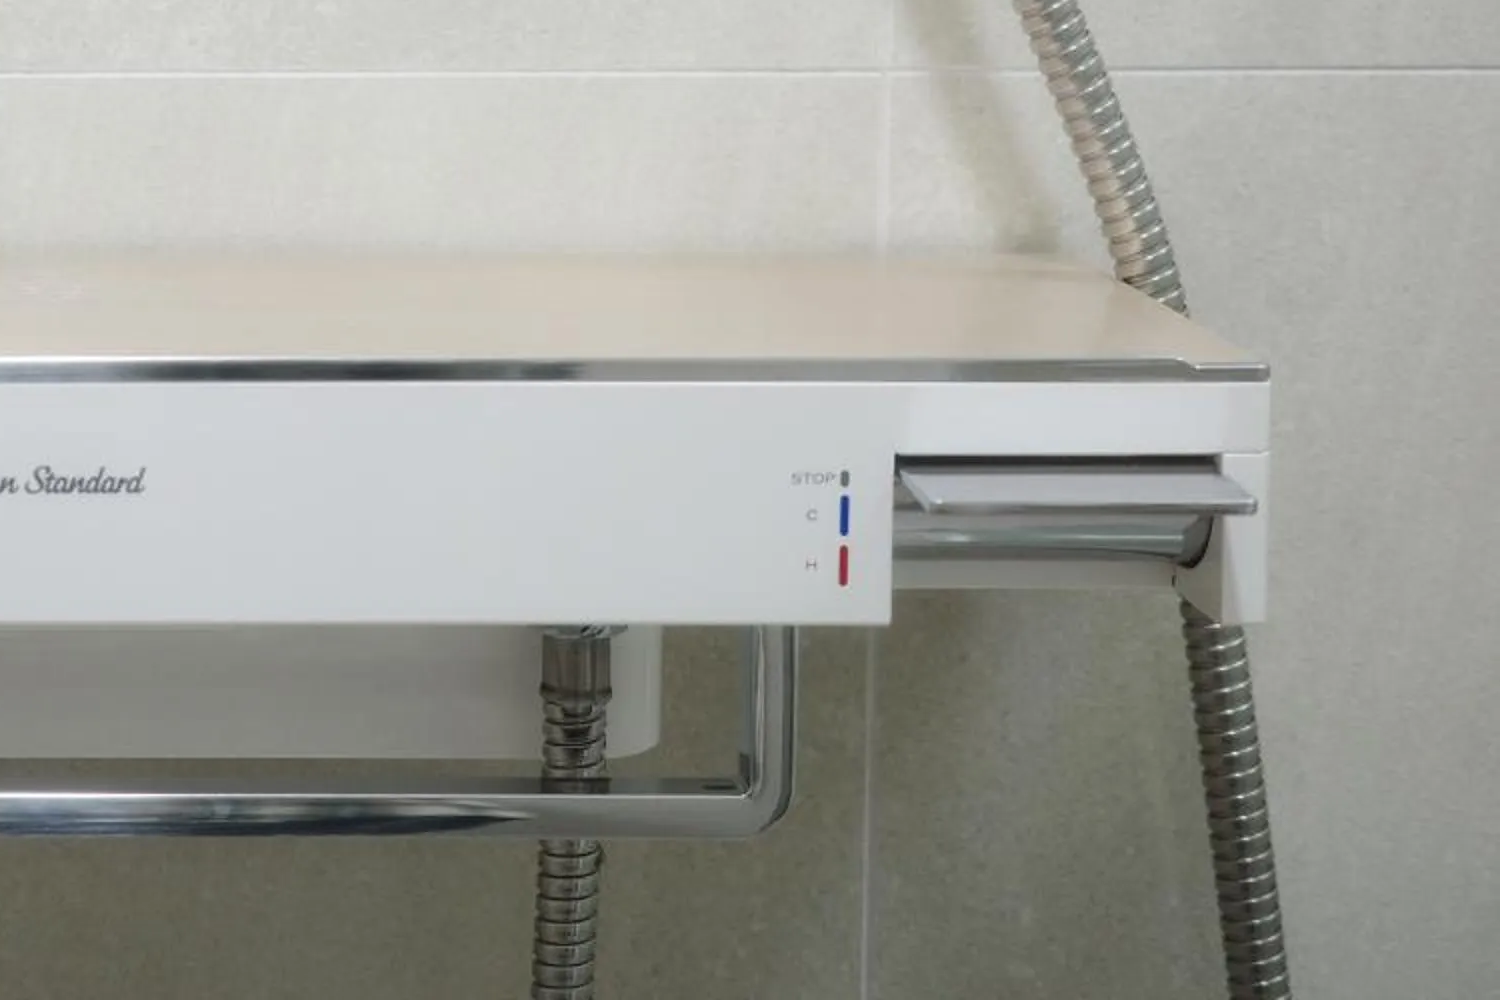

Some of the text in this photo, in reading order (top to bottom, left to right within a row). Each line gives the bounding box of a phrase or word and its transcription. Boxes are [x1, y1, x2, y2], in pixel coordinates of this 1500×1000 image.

[24, 464, 147, 496] Standard
[791, 471, 835, 486] STOP
[806, 509, 818, 521] C
[806, 560, 817, 570] H
